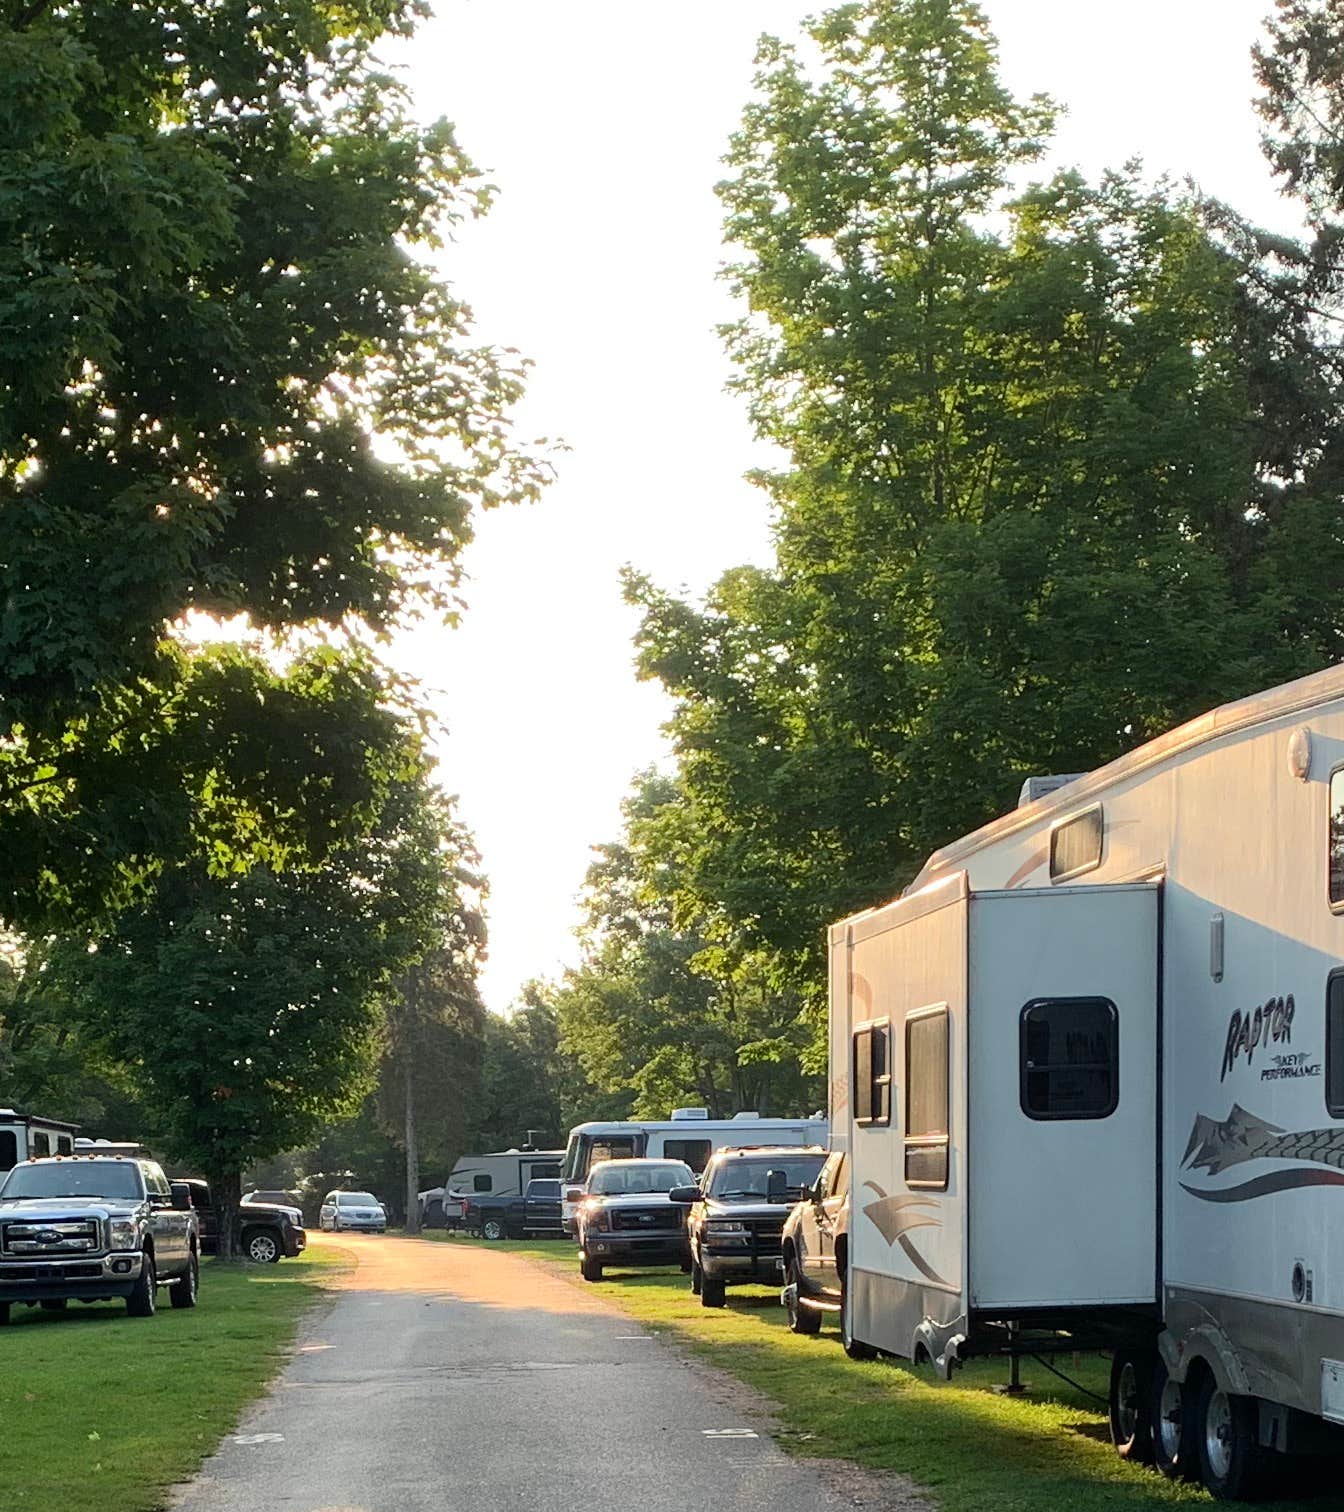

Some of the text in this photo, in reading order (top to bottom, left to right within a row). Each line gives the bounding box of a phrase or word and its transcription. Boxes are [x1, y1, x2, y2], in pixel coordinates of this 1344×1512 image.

[1220, 993, 1295, 1083] RAPTOR
[1281, 1054, 1298, 1067] KEY
[1260, 1064, 1321, 1080] PERFORMANCE
